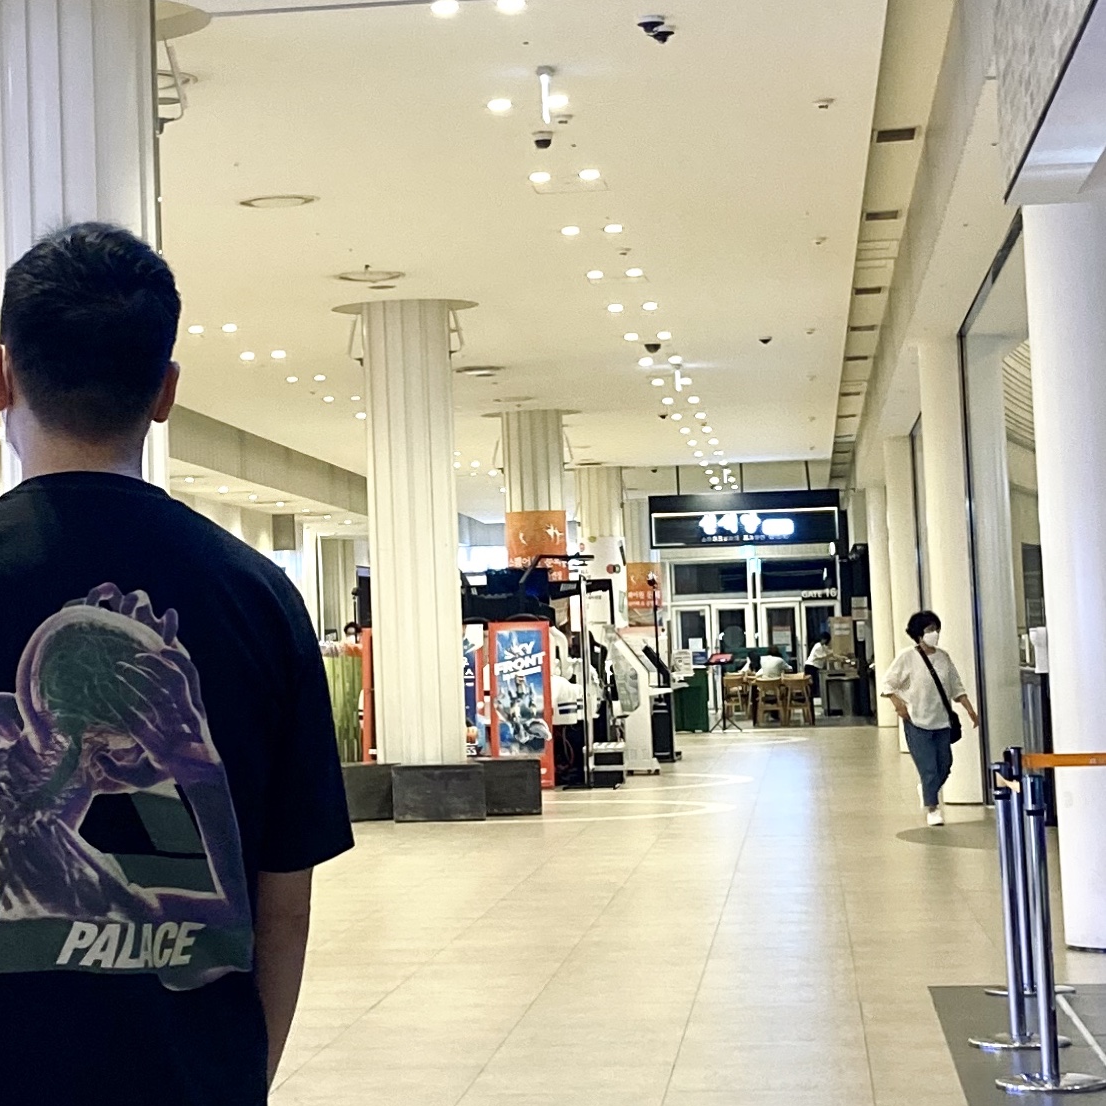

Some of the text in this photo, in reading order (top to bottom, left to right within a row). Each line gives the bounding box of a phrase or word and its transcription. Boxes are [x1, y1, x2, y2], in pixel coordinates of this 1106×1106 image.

[801, 587, 837, 598] GATE 16
[504, 640, 535, 659] SKY
[494, 651, 546, 677] FRONT
[55, 921, 207, 969] PALACE
